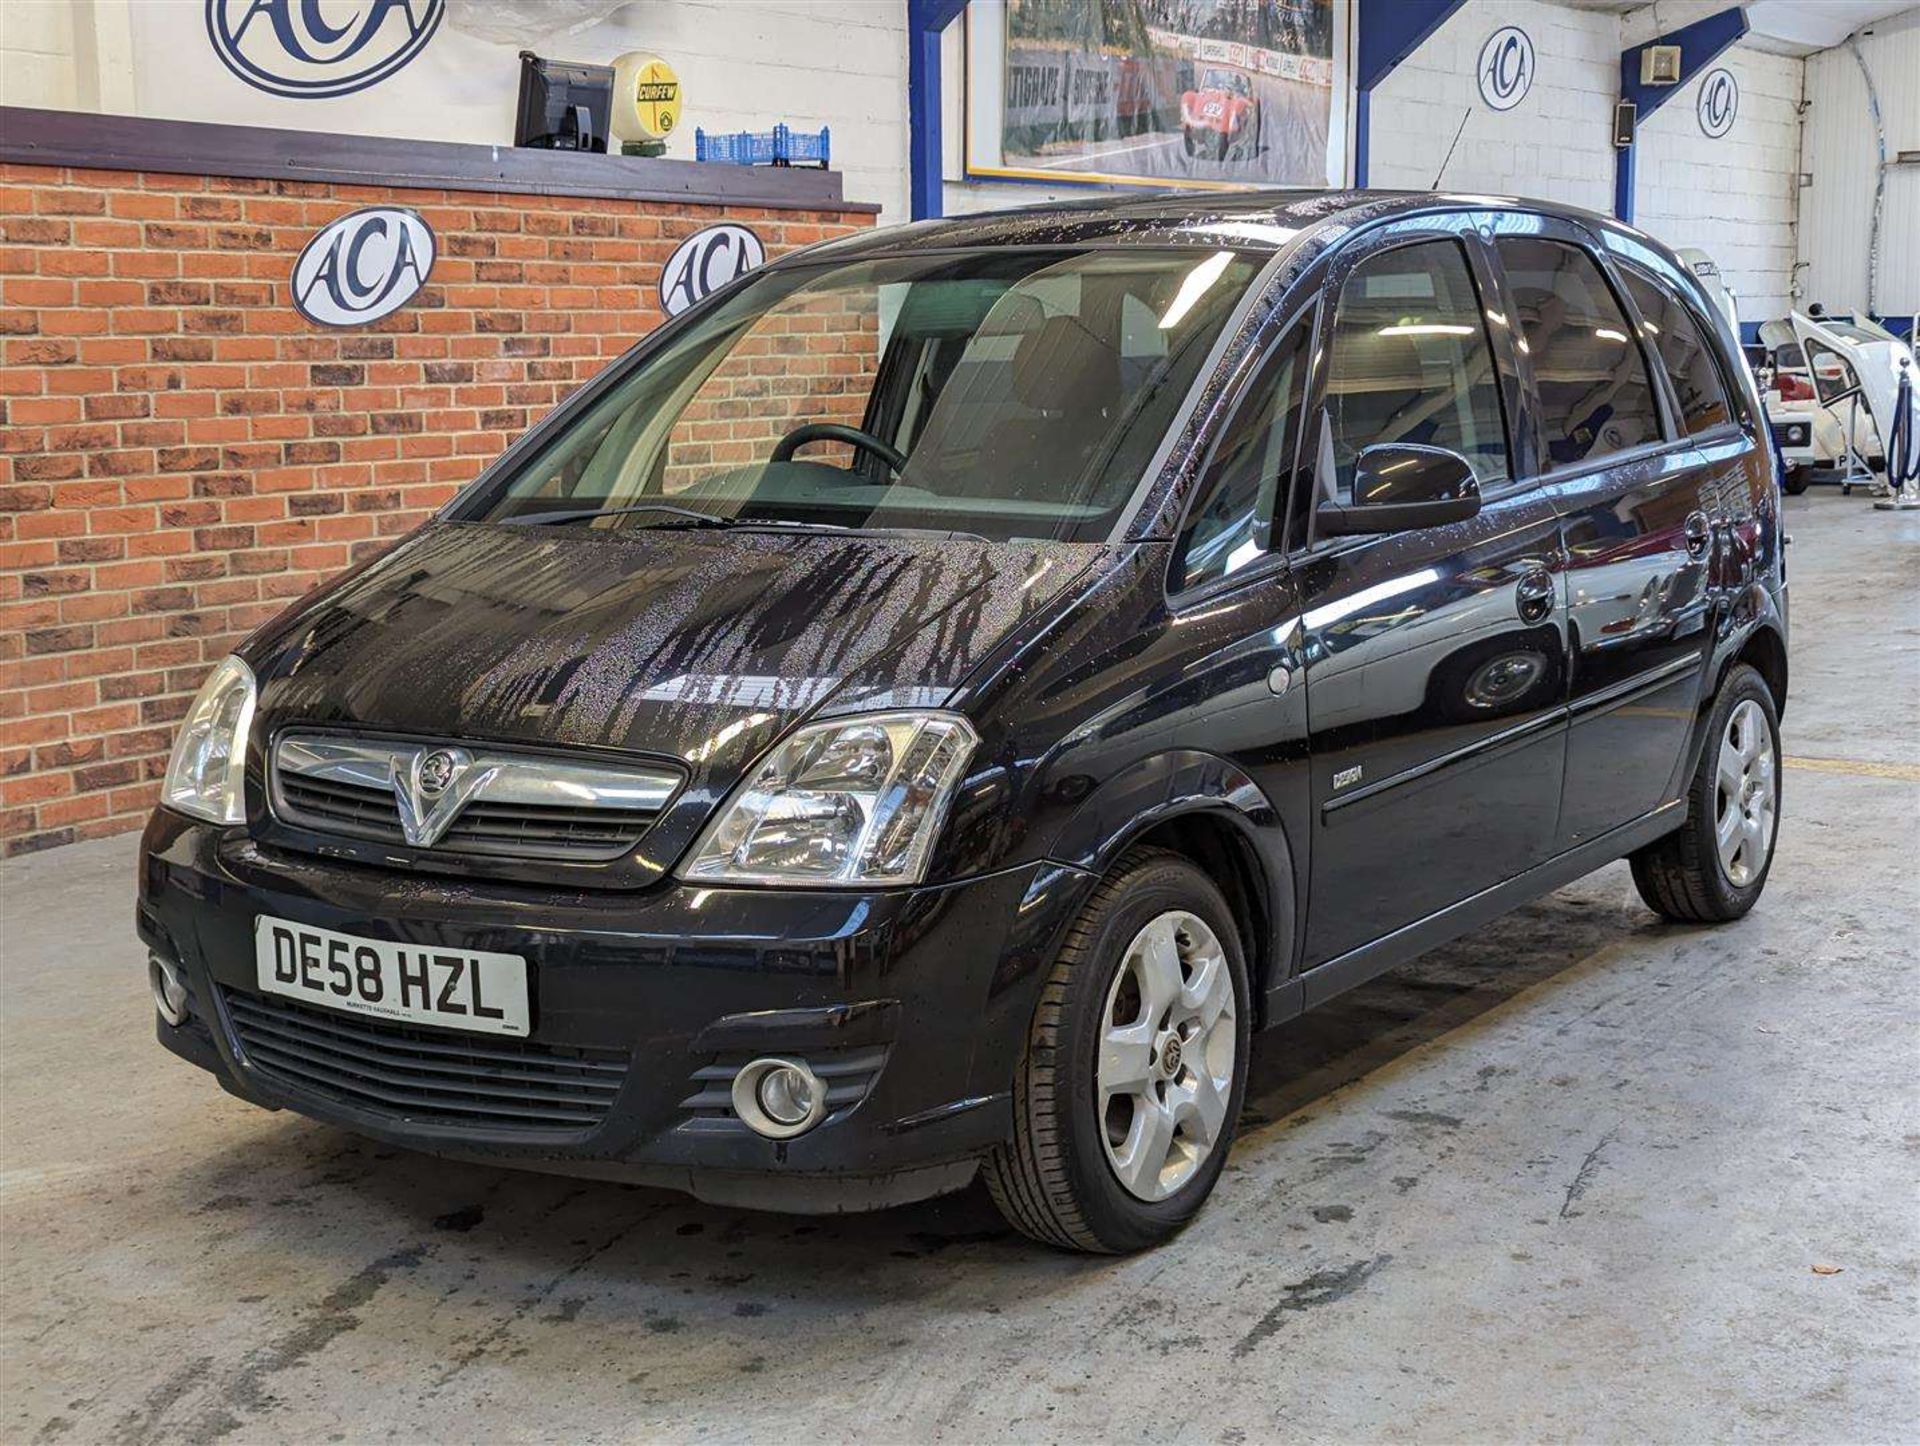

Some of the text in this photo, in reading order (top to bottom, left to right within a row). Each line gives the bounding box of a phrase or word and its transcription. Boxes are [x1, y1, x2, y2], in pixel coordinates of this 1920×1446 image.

[638, 84, 677, 100] CURFEW
[1481, 35, 1526, 98] ACA
[1701, 76, 1732, 128] ACA
[302, 216, 422, 311] ACA
[272, 926, 504, 1020] DE58 HZL
